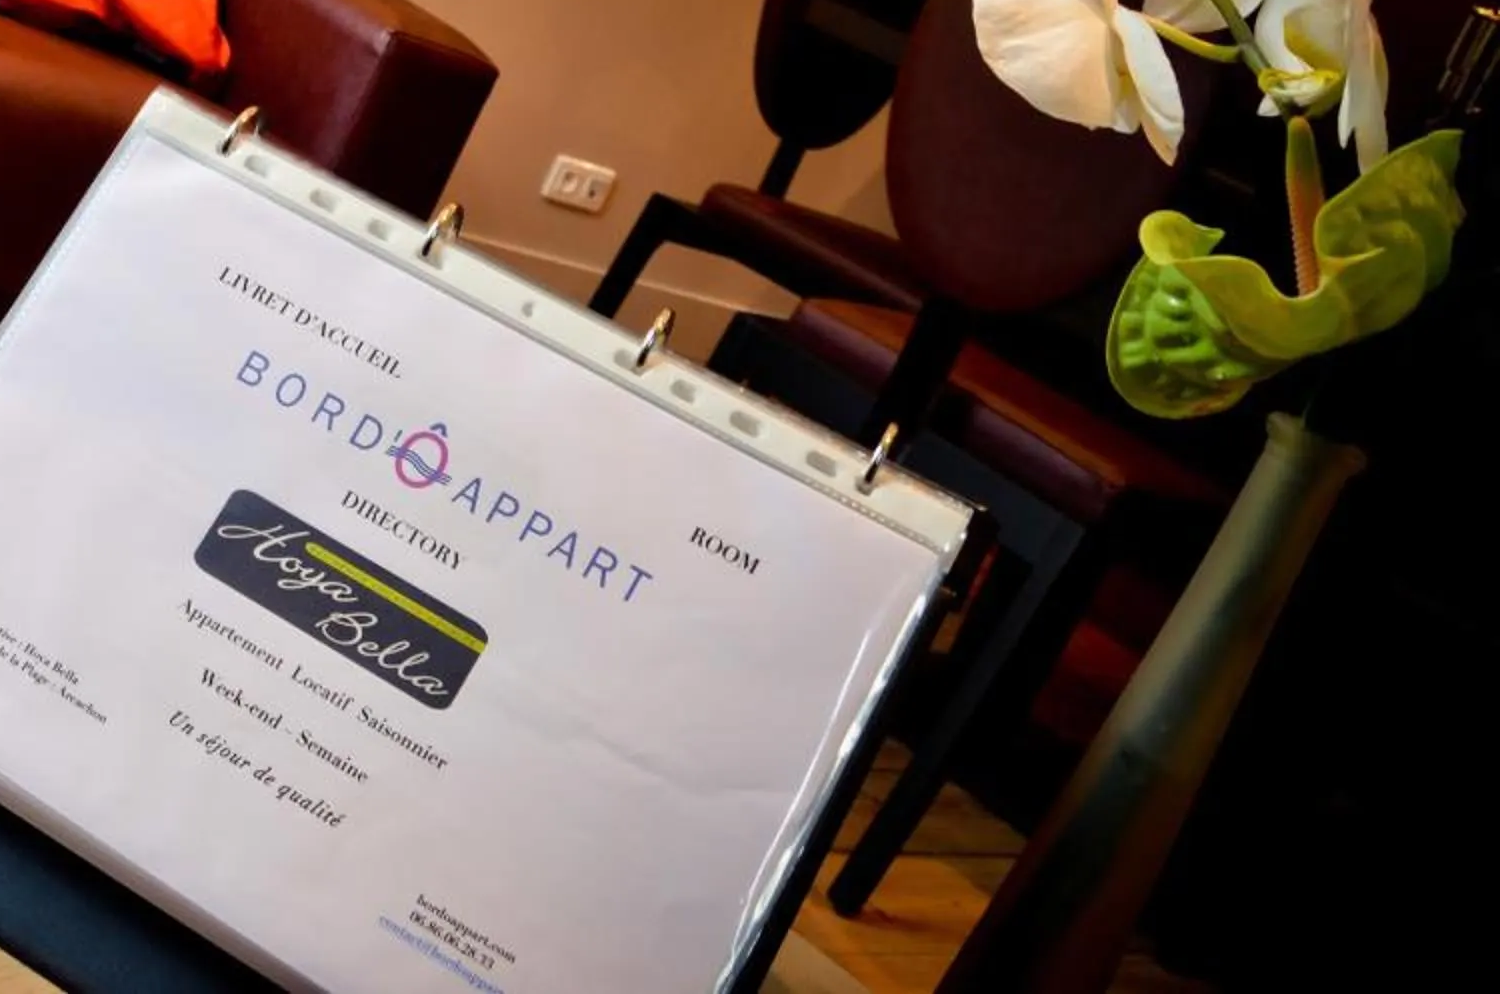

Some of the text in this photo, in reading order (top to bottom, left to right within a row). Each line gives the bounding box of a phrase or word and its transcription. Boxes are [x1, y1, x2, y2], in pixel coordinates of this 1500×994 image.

[218, 266, 402, 378] LIVRET D'ACCUEIL
[217, 522, 358, 604] Hoya
[341, 490, 468, 573] DIRECTORY
[690, 524, 762, 576] ROOM
[179, 598, 285, 671] Appartement
[291, 665, 355, 711] Locatif
[357, 706, 448, 771] Saisonnier
[315, 611, 449, 696] Bella
[168, 709, 346, 828] Un séjour de qualité
[200, 667, 284, 730] Week-end
[296, 728, 369, 784] Semaine
